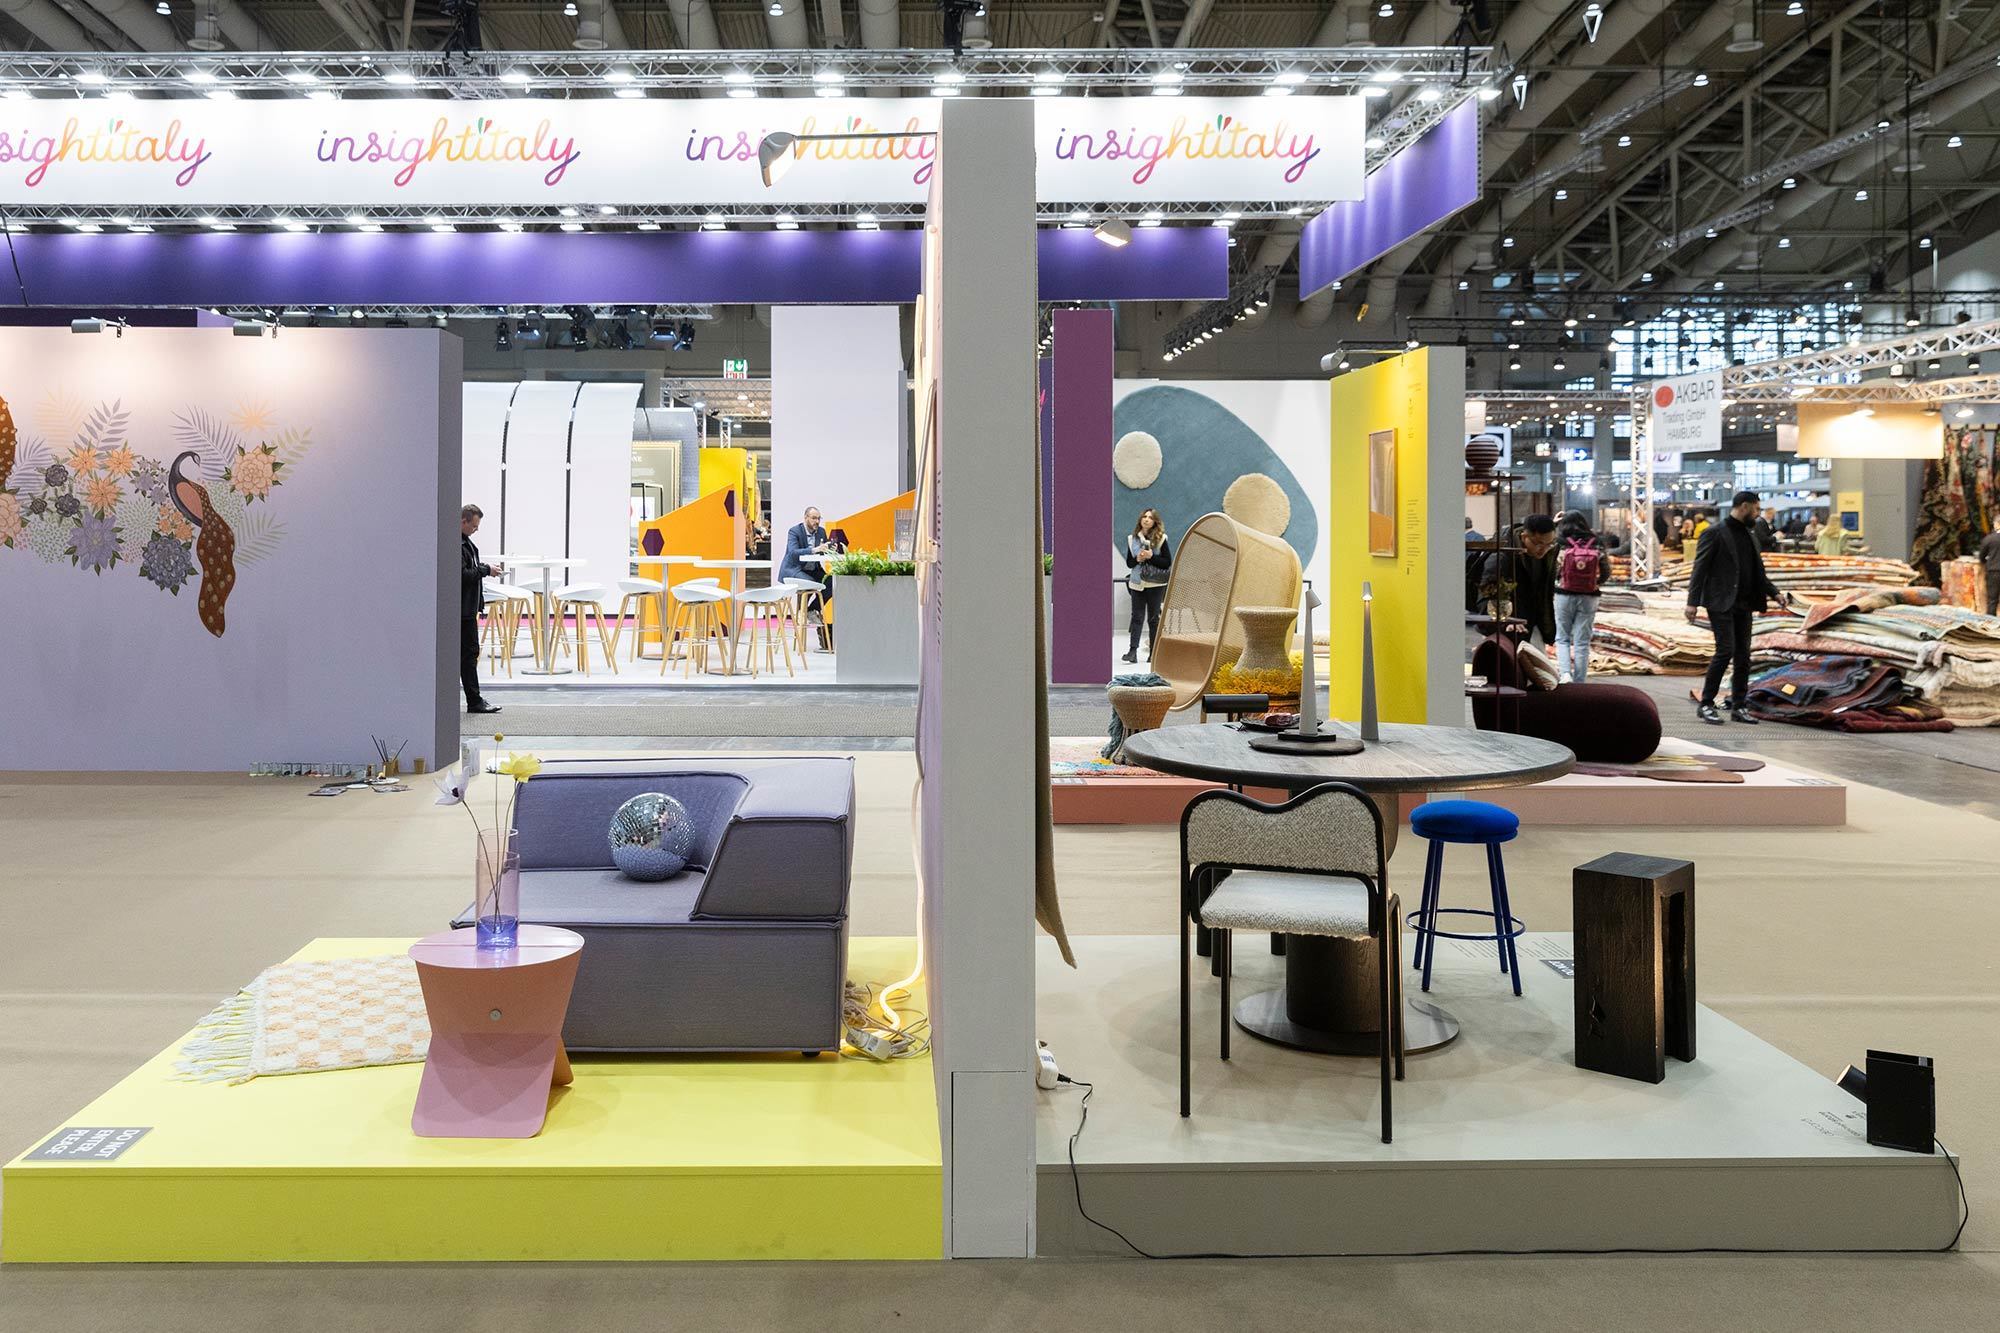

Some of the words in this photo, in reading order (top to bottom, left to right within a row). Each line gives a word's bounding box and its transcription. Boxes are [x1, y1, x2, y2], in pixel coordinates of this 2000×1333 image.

[317, 116, 581, 187] insightitaly
[1055, 114, 1321, 185] insightitaly
[1675, 379, 1716, 404] AKBAR
[1662, 411, 1685, 426] Trading
[1686, 408, 1706, 422] GmbH
[1666, 425, 1702, 440] HAMBURG
[45, 1129, 90, 1155] PLEASE
[115, 1129, 141, 1141] DO
[94, 1140, 126, 1158] NOT
